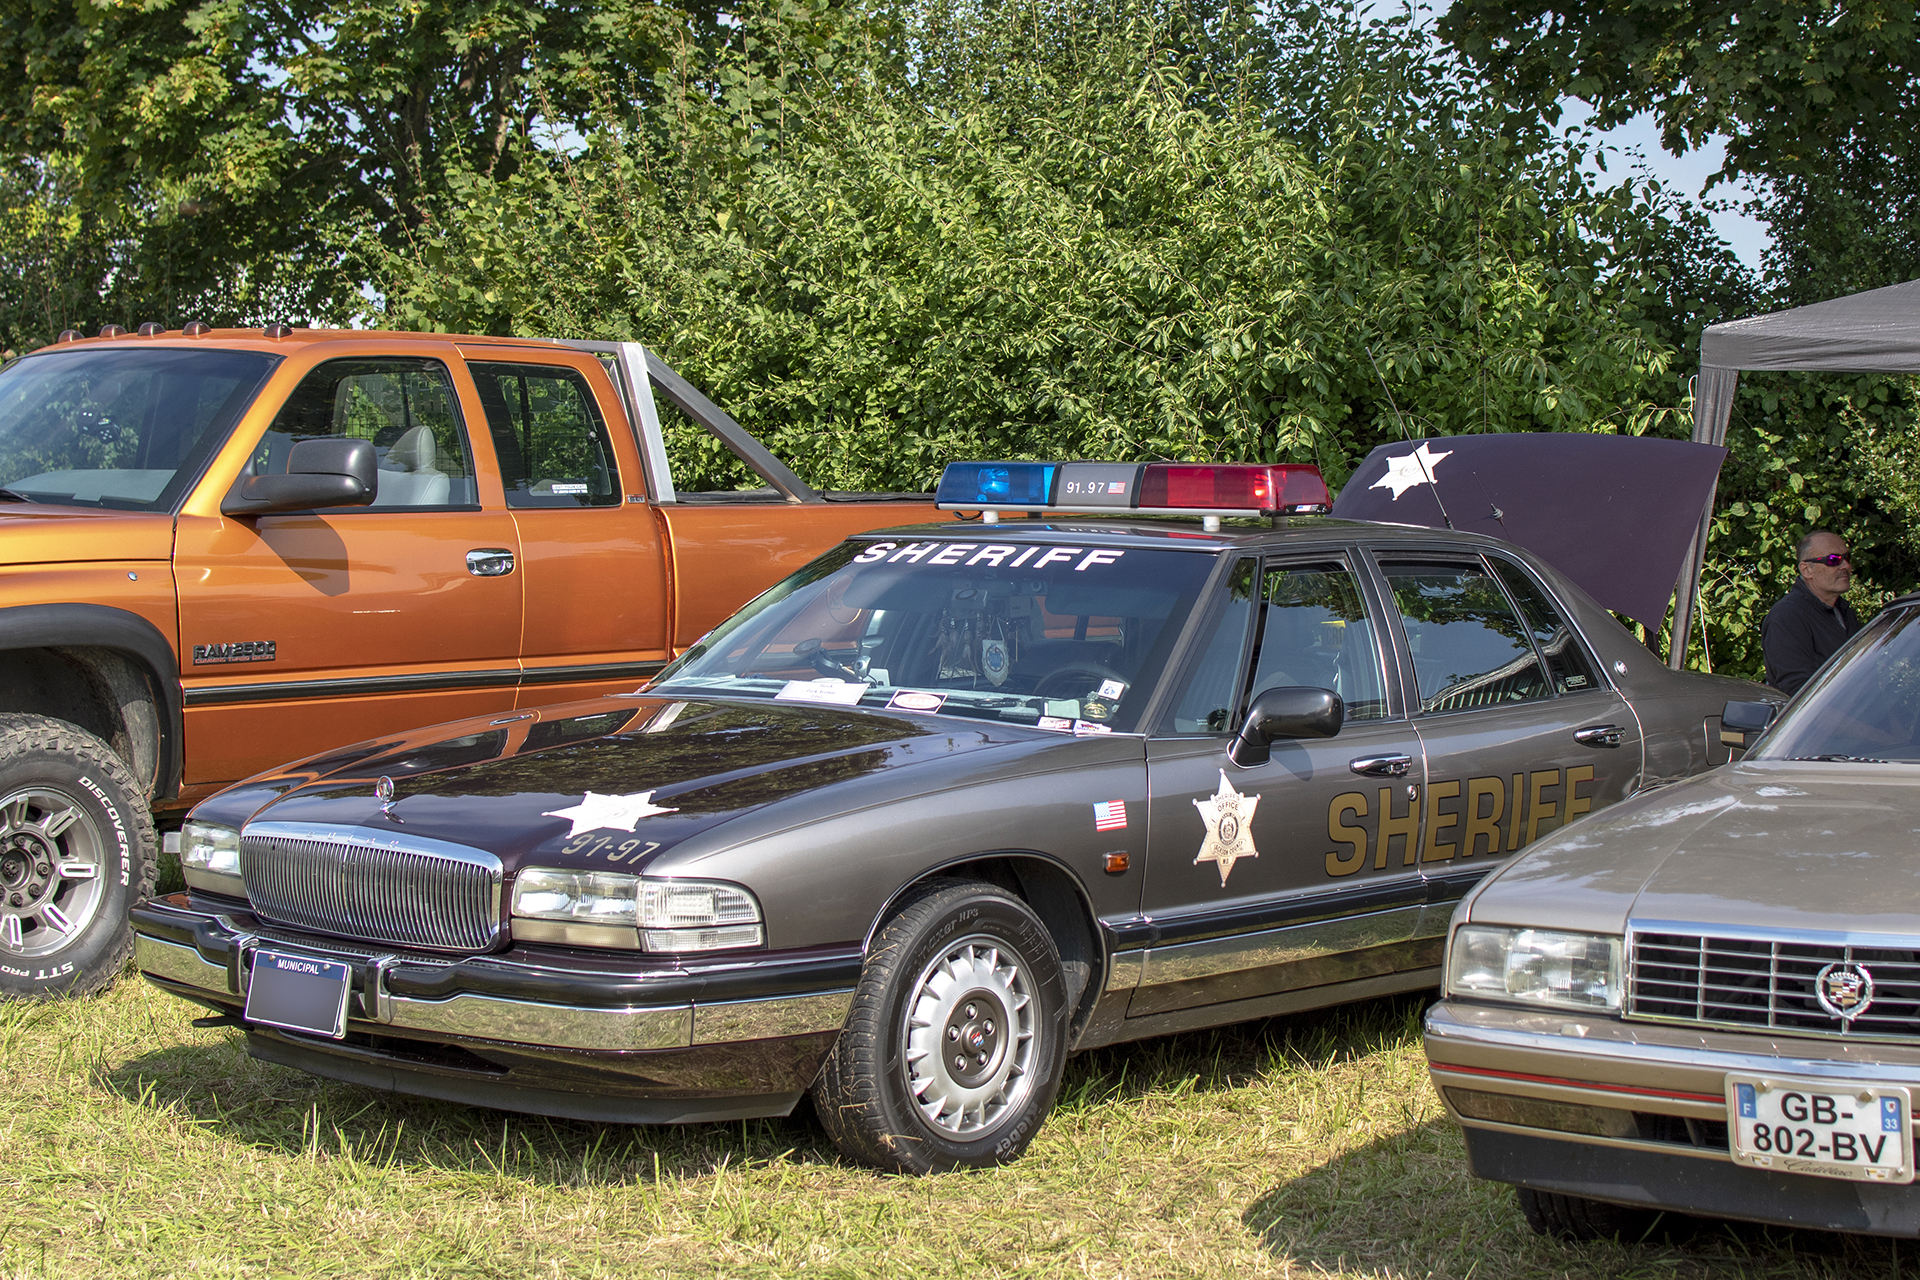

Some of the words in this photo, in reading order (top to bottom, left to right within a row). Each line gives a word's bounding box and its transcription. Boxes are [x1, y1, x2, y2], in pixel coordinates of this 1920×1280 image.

[1066, 481, 1105, 494] 91.97
[853, 542, 1125, 571] SHERIFF
[193, 643, 229, 658] RAM
[231, 640, 276, 656] 2500
[1217, 801, 1239, 812] OFFICE
[1324, 764, 1595, 878] SHERIFF
[78, 776, 130, 887] DISCOVERER
[561, 833, 661, 865] 91-97
[0, 964, 31, 977] PRO
[34, 961, 74, 980] STT
[277, 959, 320, 975] MUNICIPAL
[1743, 1103, 1752, 1115] F
[1781, 1092, 1854, 1125] GB-
[1884, 1117, 1898, 1130] 33
[1753, 1122, 1887, 1164] 802-BV
[1784, 1158, 1853, 1177] Cadillac
